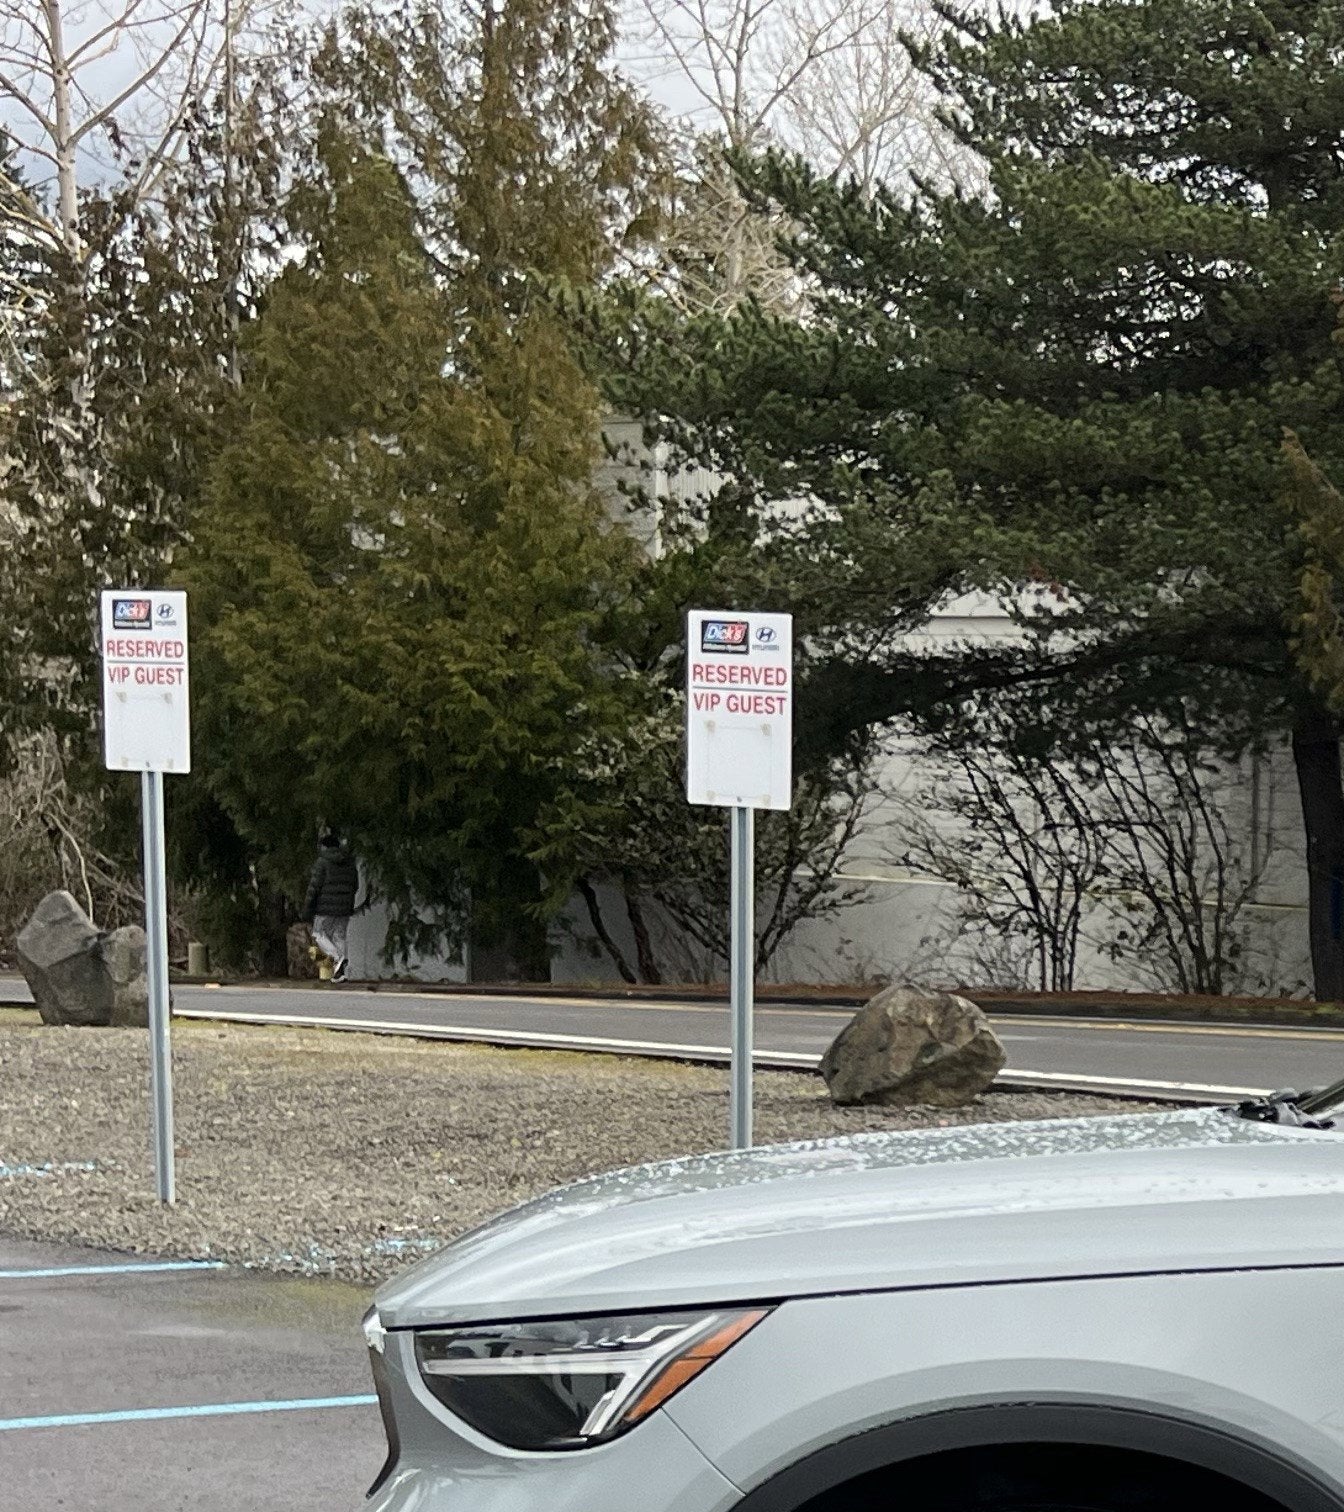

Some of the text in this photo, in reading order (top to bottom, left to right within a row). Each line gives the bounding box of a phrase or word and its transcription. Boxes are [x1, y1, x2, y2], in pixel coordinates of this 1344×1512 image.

[107, 640, 184, 658] RESERVED
[107, 666, 184, 685] VIP GUEST
[693, 665, 787, 686] RESERVED
[693, 693, 787, 715] VIP GUEST
